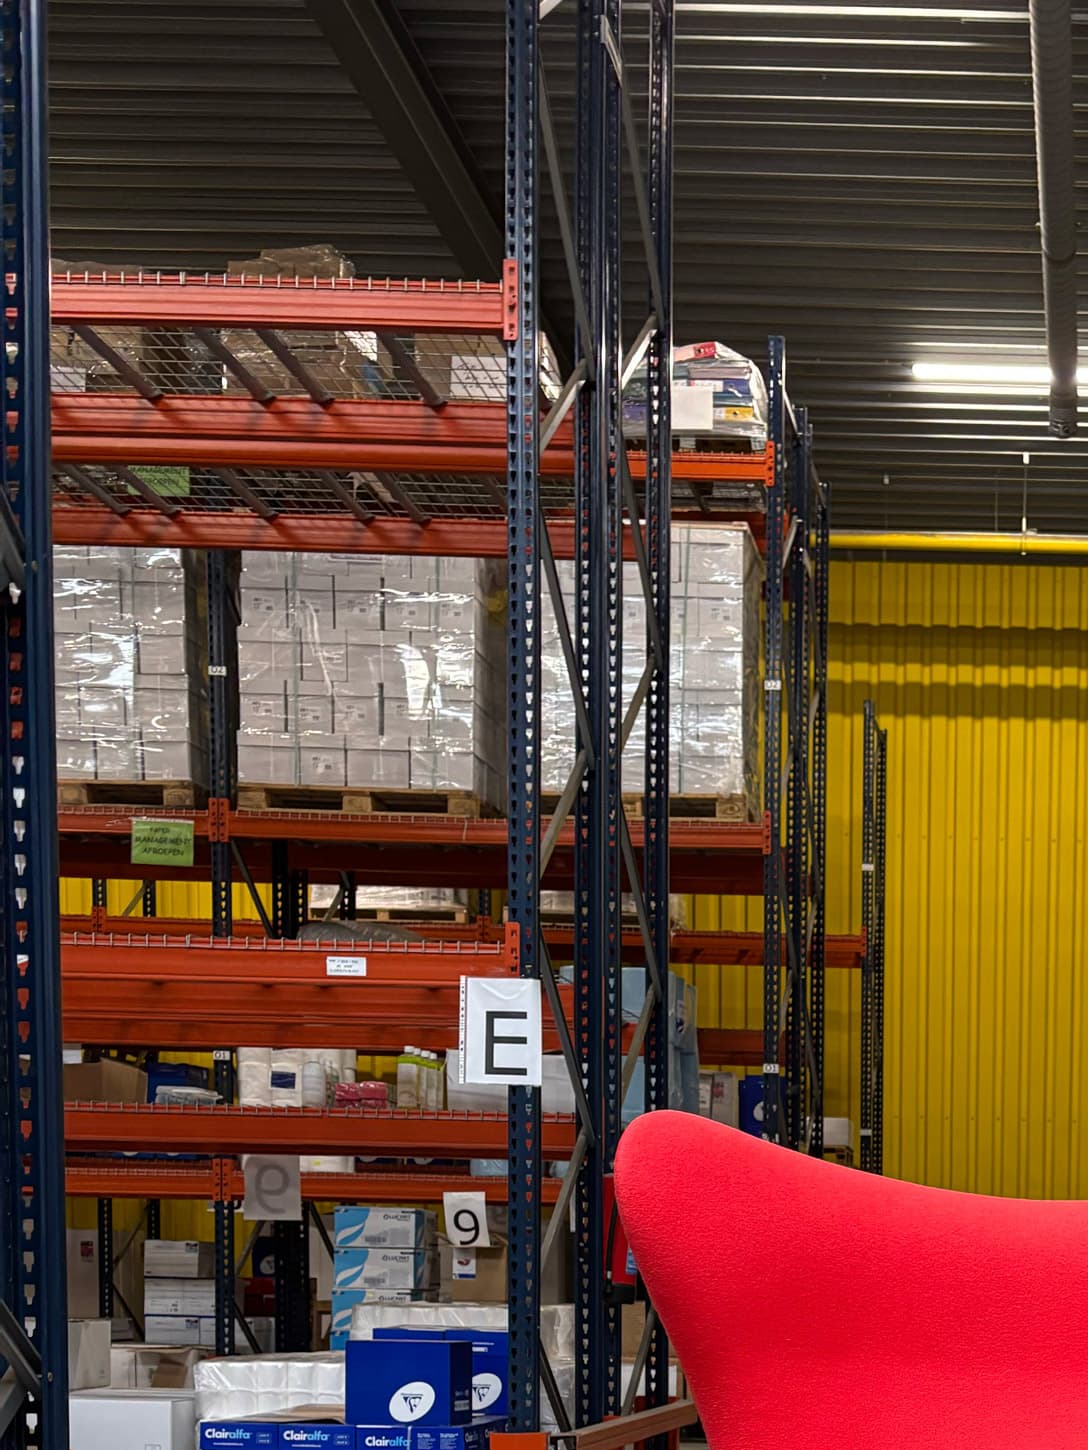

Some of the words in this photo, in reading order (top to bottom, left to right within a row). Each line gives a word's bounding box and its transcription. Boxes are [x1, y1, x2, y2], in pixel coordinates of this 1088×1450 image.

[484, 1010, 528, 1076] E
[453, 1209, 480, 1246] 9
[205, 1427, 251, 1440] Clairalfa
[283, 1429, 329, 1442] Clairalfa
